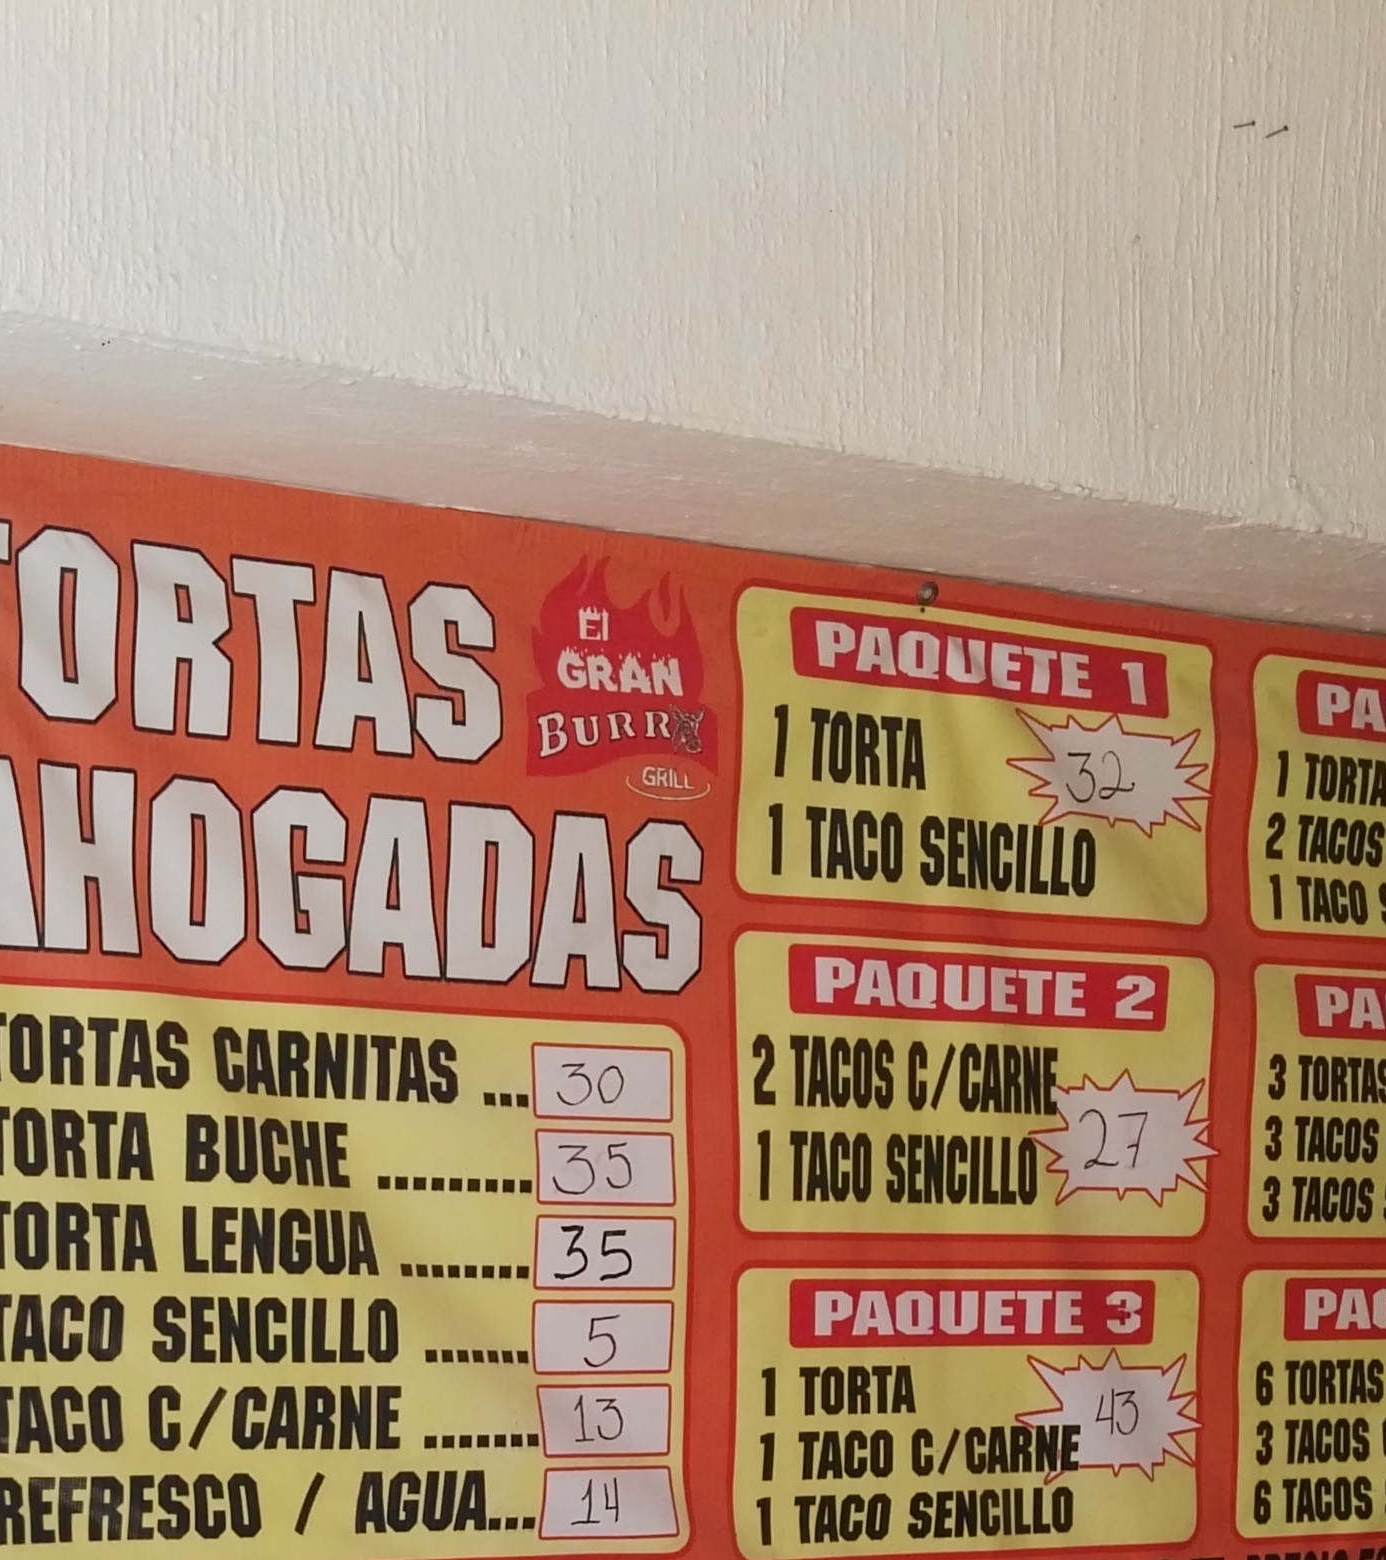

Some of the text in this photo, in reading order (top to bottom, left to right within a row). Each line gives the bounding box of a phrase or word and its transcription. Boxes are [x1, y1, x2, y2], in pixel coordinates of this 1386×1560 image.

[557, 648, 683, 696] GRAN
[813, 619, 1148, 706] PAQUETE 1
[774, 704, 926, 791] 1 TORTA
[1277, 750, 1289, 798] 1
[642, 766, 696, 790] GRILL
[1065, 749, 1136, 803] 32
[768, 803, 1096, 898] 1 TACO SENCILLO
[1265, 812, 1286, 861] 2
[1298, 814, 1386, 869] TACOS
[1269, 873, 1283, 920] 1
[1296, 876, 1369, 925] TACO
[813, 956, 1156, 1021] PAQUETE 2
[213, 1028, 459, 1105] CARNITAS
[555, 1061, 626, 1107] 30
[752, 1034, 1059, 1116] 2 TACOS C/CARNE
[1268, 1053, 1287, 1101] 3
[185, 1114, 351, 1189] BUCHE
[1079, 1108, 1149, 1170] 27
[1265, 1115, 1283, 1162] 3
[1295, 1116, 1379, 1164] TACOS
[553, 1142, 633, 1194] 35
[757, 1129, 1038, 1205] 1 TACO SENCILLO
[1262, 1175, 1281, 1222] 3
[1293, 1176, 1375, 1223] TACOS
[182, 1208, 380, 1277] LENGUA
[555, 1225, 633, 1282] 35
[151, 1297, 401, 1364] SENCILLO
[813, 1289, 1143, 1337] PAQUETE 3
[582, 1314, 621, 1368] 5
[761, 1365, 916, 1416] 1 TORTA
[1255, 1359, 1384, 1406] 6 TORTAS
[148, 1385, 402, 1453] C/CARNE
[574, 1395, 625, 1446] 13
[1095, 1387, 1140, 1435] 43
[760, 1424, 1082, 1481] 1 TACO C/CARNE
[1255, 1420, 1273, 1466] 3
[1285, 1416, 1370, 1465] TACOS
[569, 1476, 621, 1527] 14
[756, 1486, 1074, 1545] 1 TACO SENCILLO
[1253, 1479, 1272, 1525] 6
[1282, 1475, 1374, 1523] TACOS
